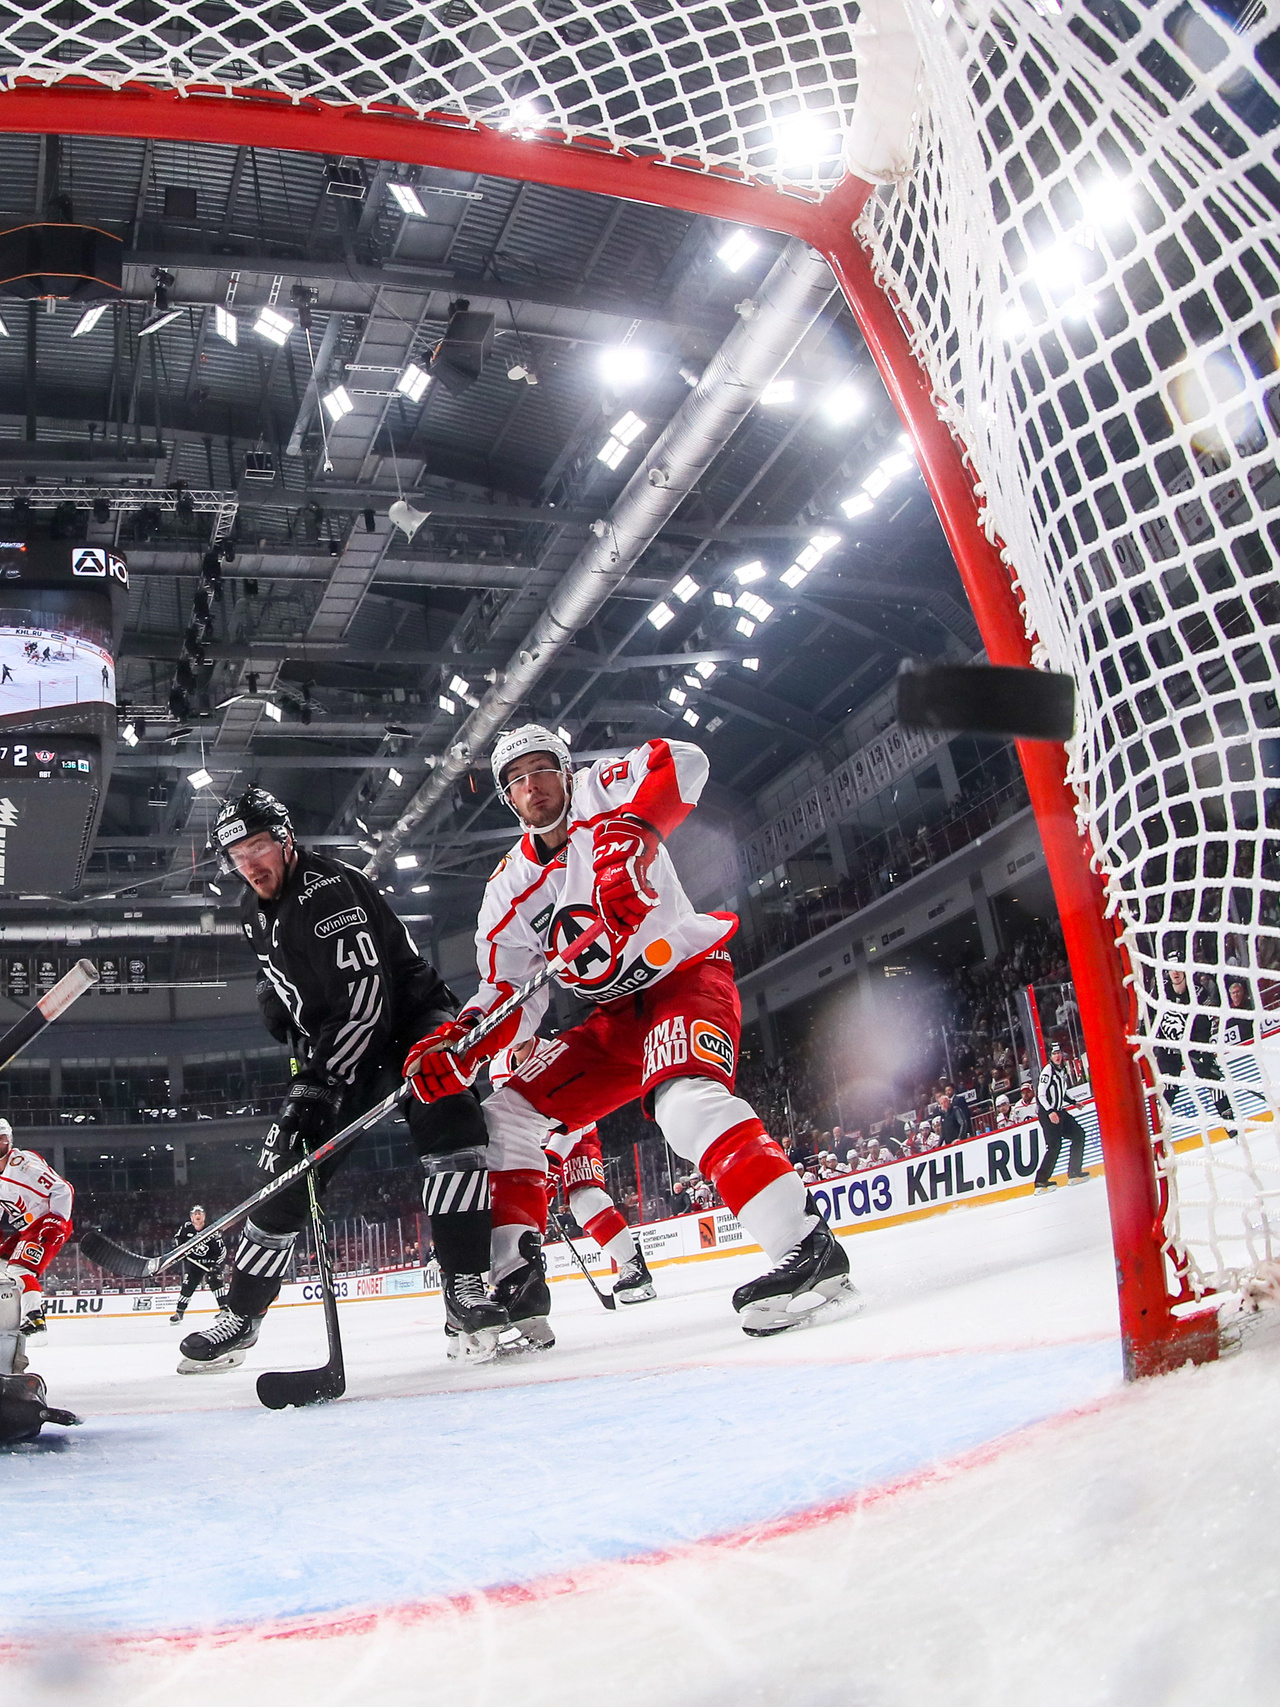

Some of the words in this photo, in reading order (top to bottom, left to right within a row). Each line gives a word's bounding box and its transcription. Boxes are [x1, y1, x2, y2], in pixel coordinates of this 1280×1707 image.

[13, 745, 28, 766] 2
[298, 875, 342, 905] Ариант
[319, 913, 358, 934] Winline
[336, 931, 379, 972] 40
[704, 1034, 733, 1062] Win
[257, 1147, 281, 1174] ГК
[563, 1155, 590, 1175] SIMA
[906, 1127, 1039, 1206] KHL.RU
[37, 1172, 56, 1190] 31
[259, 1158, 310, 1200] ALPHA
[564, 1167, 593, 1187] LAND
[814, 1174, 893, 1223] огаз
[303, 1281, 348, 1300] соаз
[357, 1276, 384, 1296] FONBET
[41, 1298, 104, 1315] HL.RU
